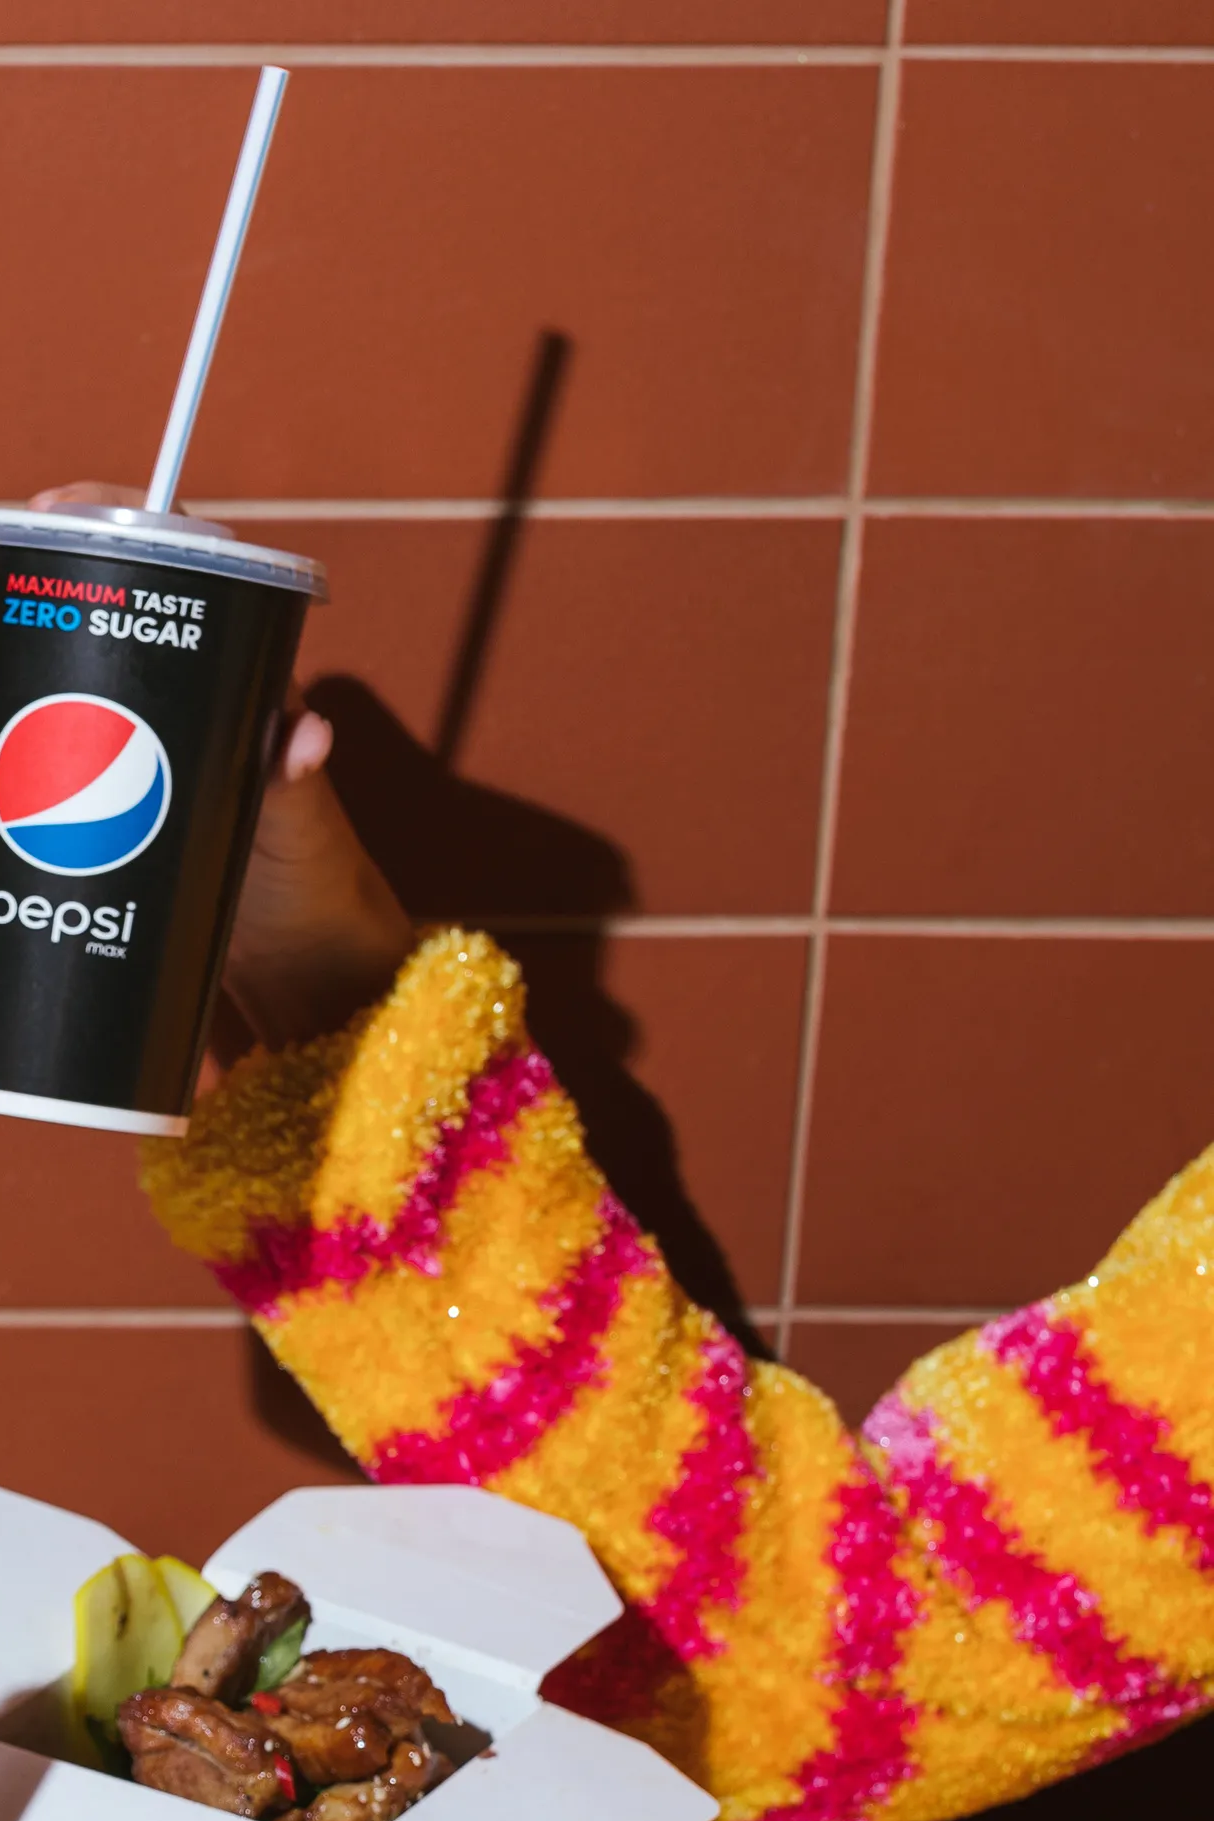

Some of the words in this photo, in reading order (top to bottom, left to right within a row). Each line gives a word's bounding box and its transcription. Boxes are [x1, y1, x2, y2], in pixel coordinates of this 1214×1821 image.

[6, 573, 126, 607] MAXIMUM
[131, 589, 207, 620] TASTE
[2, 597, 82, 632] ZERO
[88, 609, 202, 650] SUGAR
[85, 941, 127, 959] max
